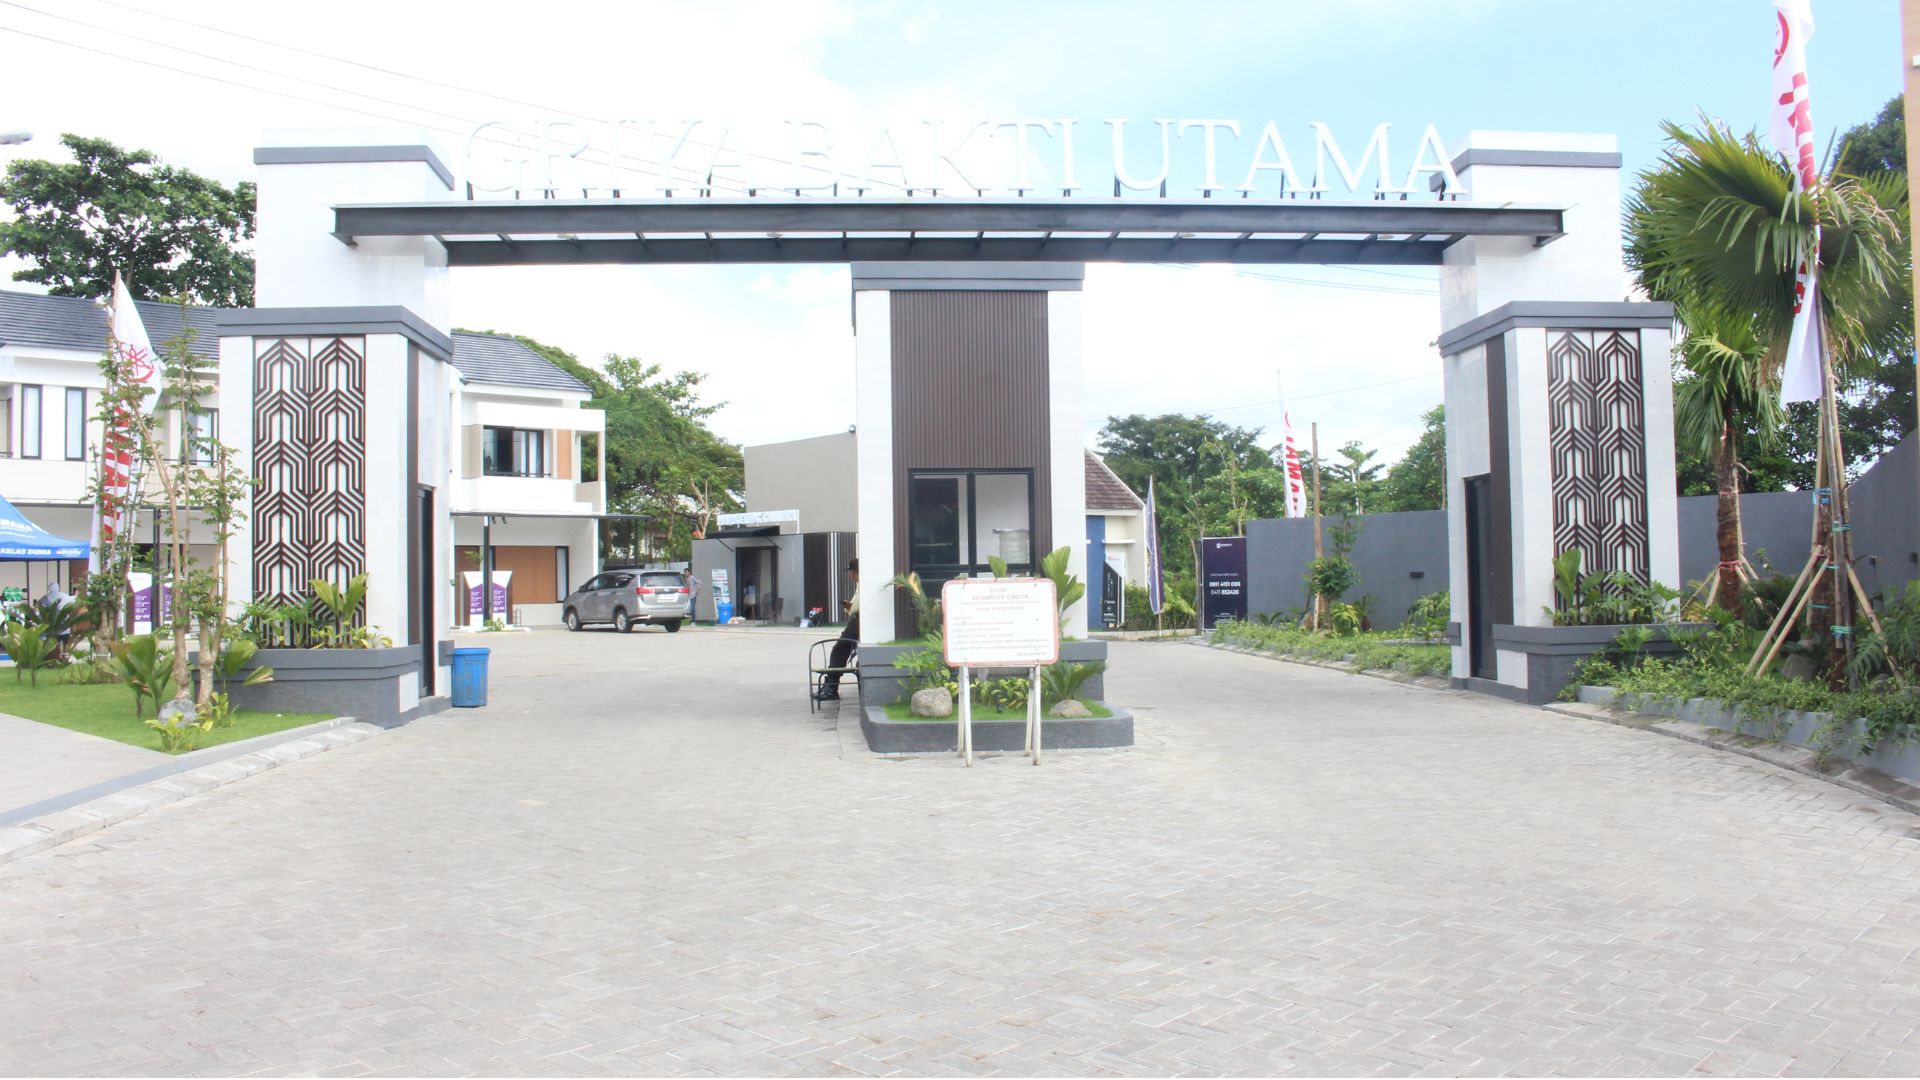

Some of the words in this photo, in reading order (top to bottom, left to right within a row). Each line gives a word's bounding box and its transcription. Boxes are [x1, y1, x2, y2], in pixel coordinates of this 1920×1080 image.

[465, 119, 767, 192] GRIYA
[783, 118, 1082, 192] BAKTI
[1103, 118, 1469, 195] UTAMA
